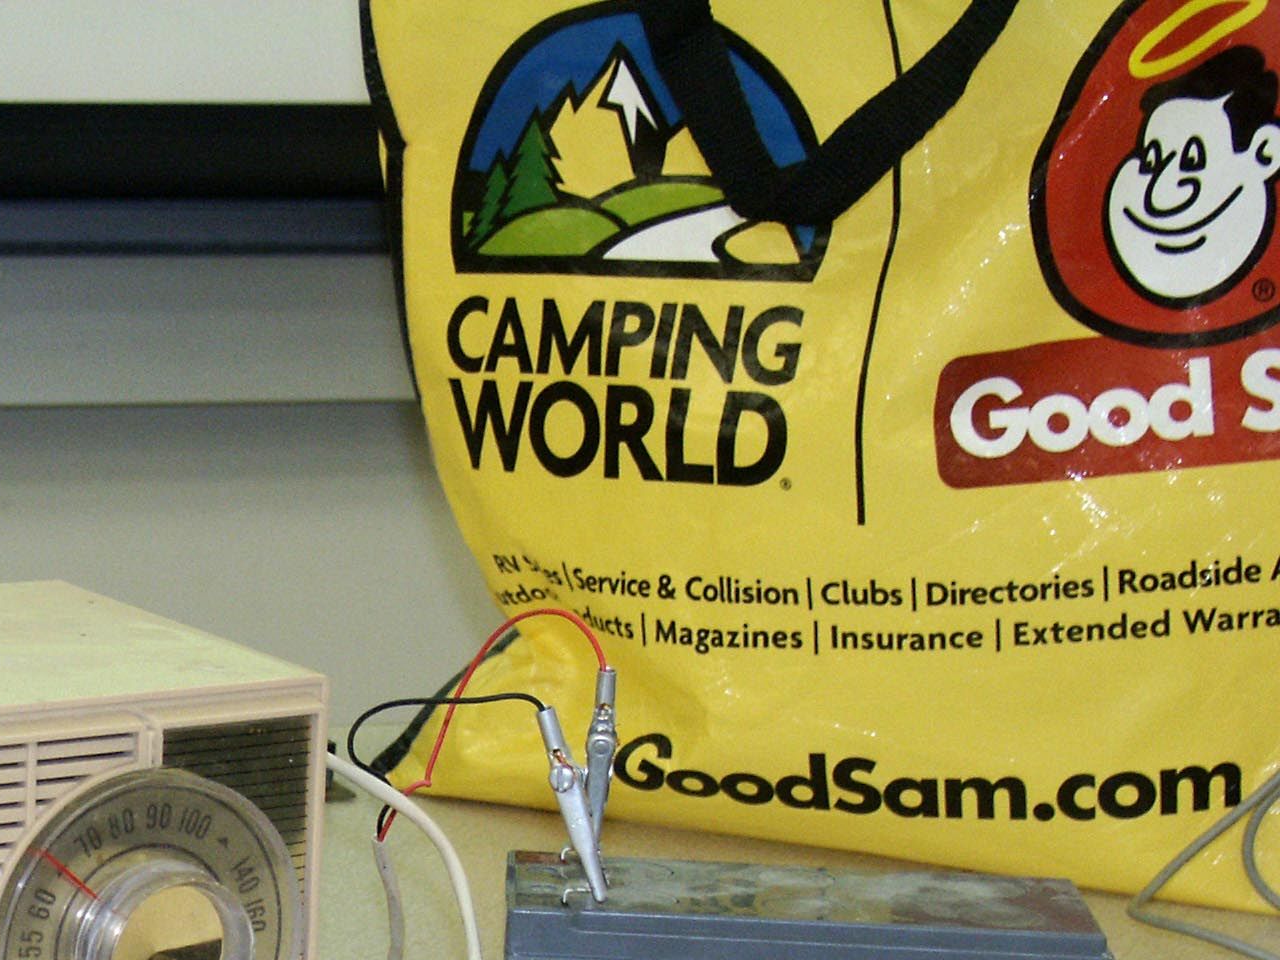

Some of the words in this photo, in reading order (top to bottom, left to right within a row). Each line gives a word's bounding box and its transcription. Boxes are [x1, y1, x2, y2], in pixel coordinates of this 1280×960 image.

[446, 295, 805, 386] CAMPING
[448, 377, 788, 487] WORLD
[949, 356, 1215, 459] Good
[572, 567, 651, 598] Service
[657, 573, 676, 600] &
[685, 575, 799, 606] Collision
[821, 580, 903, 606] Clubs
[925, 573, 1094, 606] Directories
[1117, 556, 1262, 595] Roadside
[655, 619, 803, 655] Magazines
[831, 625, 983, 652] Insurance
[1013, 608, 1170, 646] Extended
[1183, 608, 1280, 634] Warra
[613, 733, 1243, 822] GoodSam.com
[29, 889, 57, 920] 60
[147, 804, 172, 830] 90
[180, 811, 212, 840] 100
